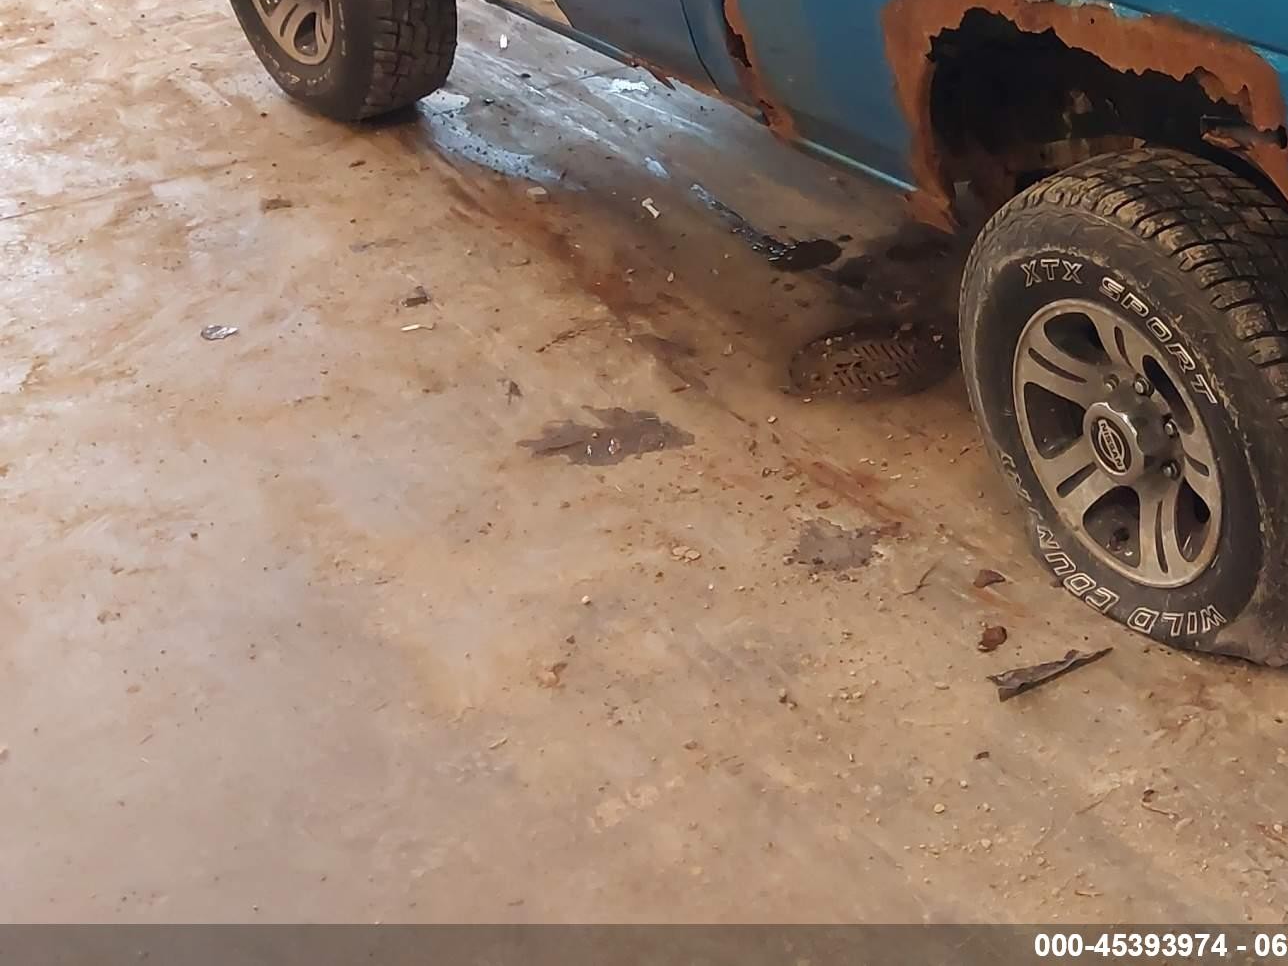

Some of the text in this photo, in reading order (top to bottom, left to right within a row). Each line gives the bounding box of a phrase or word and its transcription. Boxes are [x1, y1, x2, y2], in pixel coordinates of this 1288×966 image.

[1021, 259, 1218, 404] XTX SPORT
[1100, 422, 1124, 467] NISSAN
[1127, 605, 1227, 637] WILD
